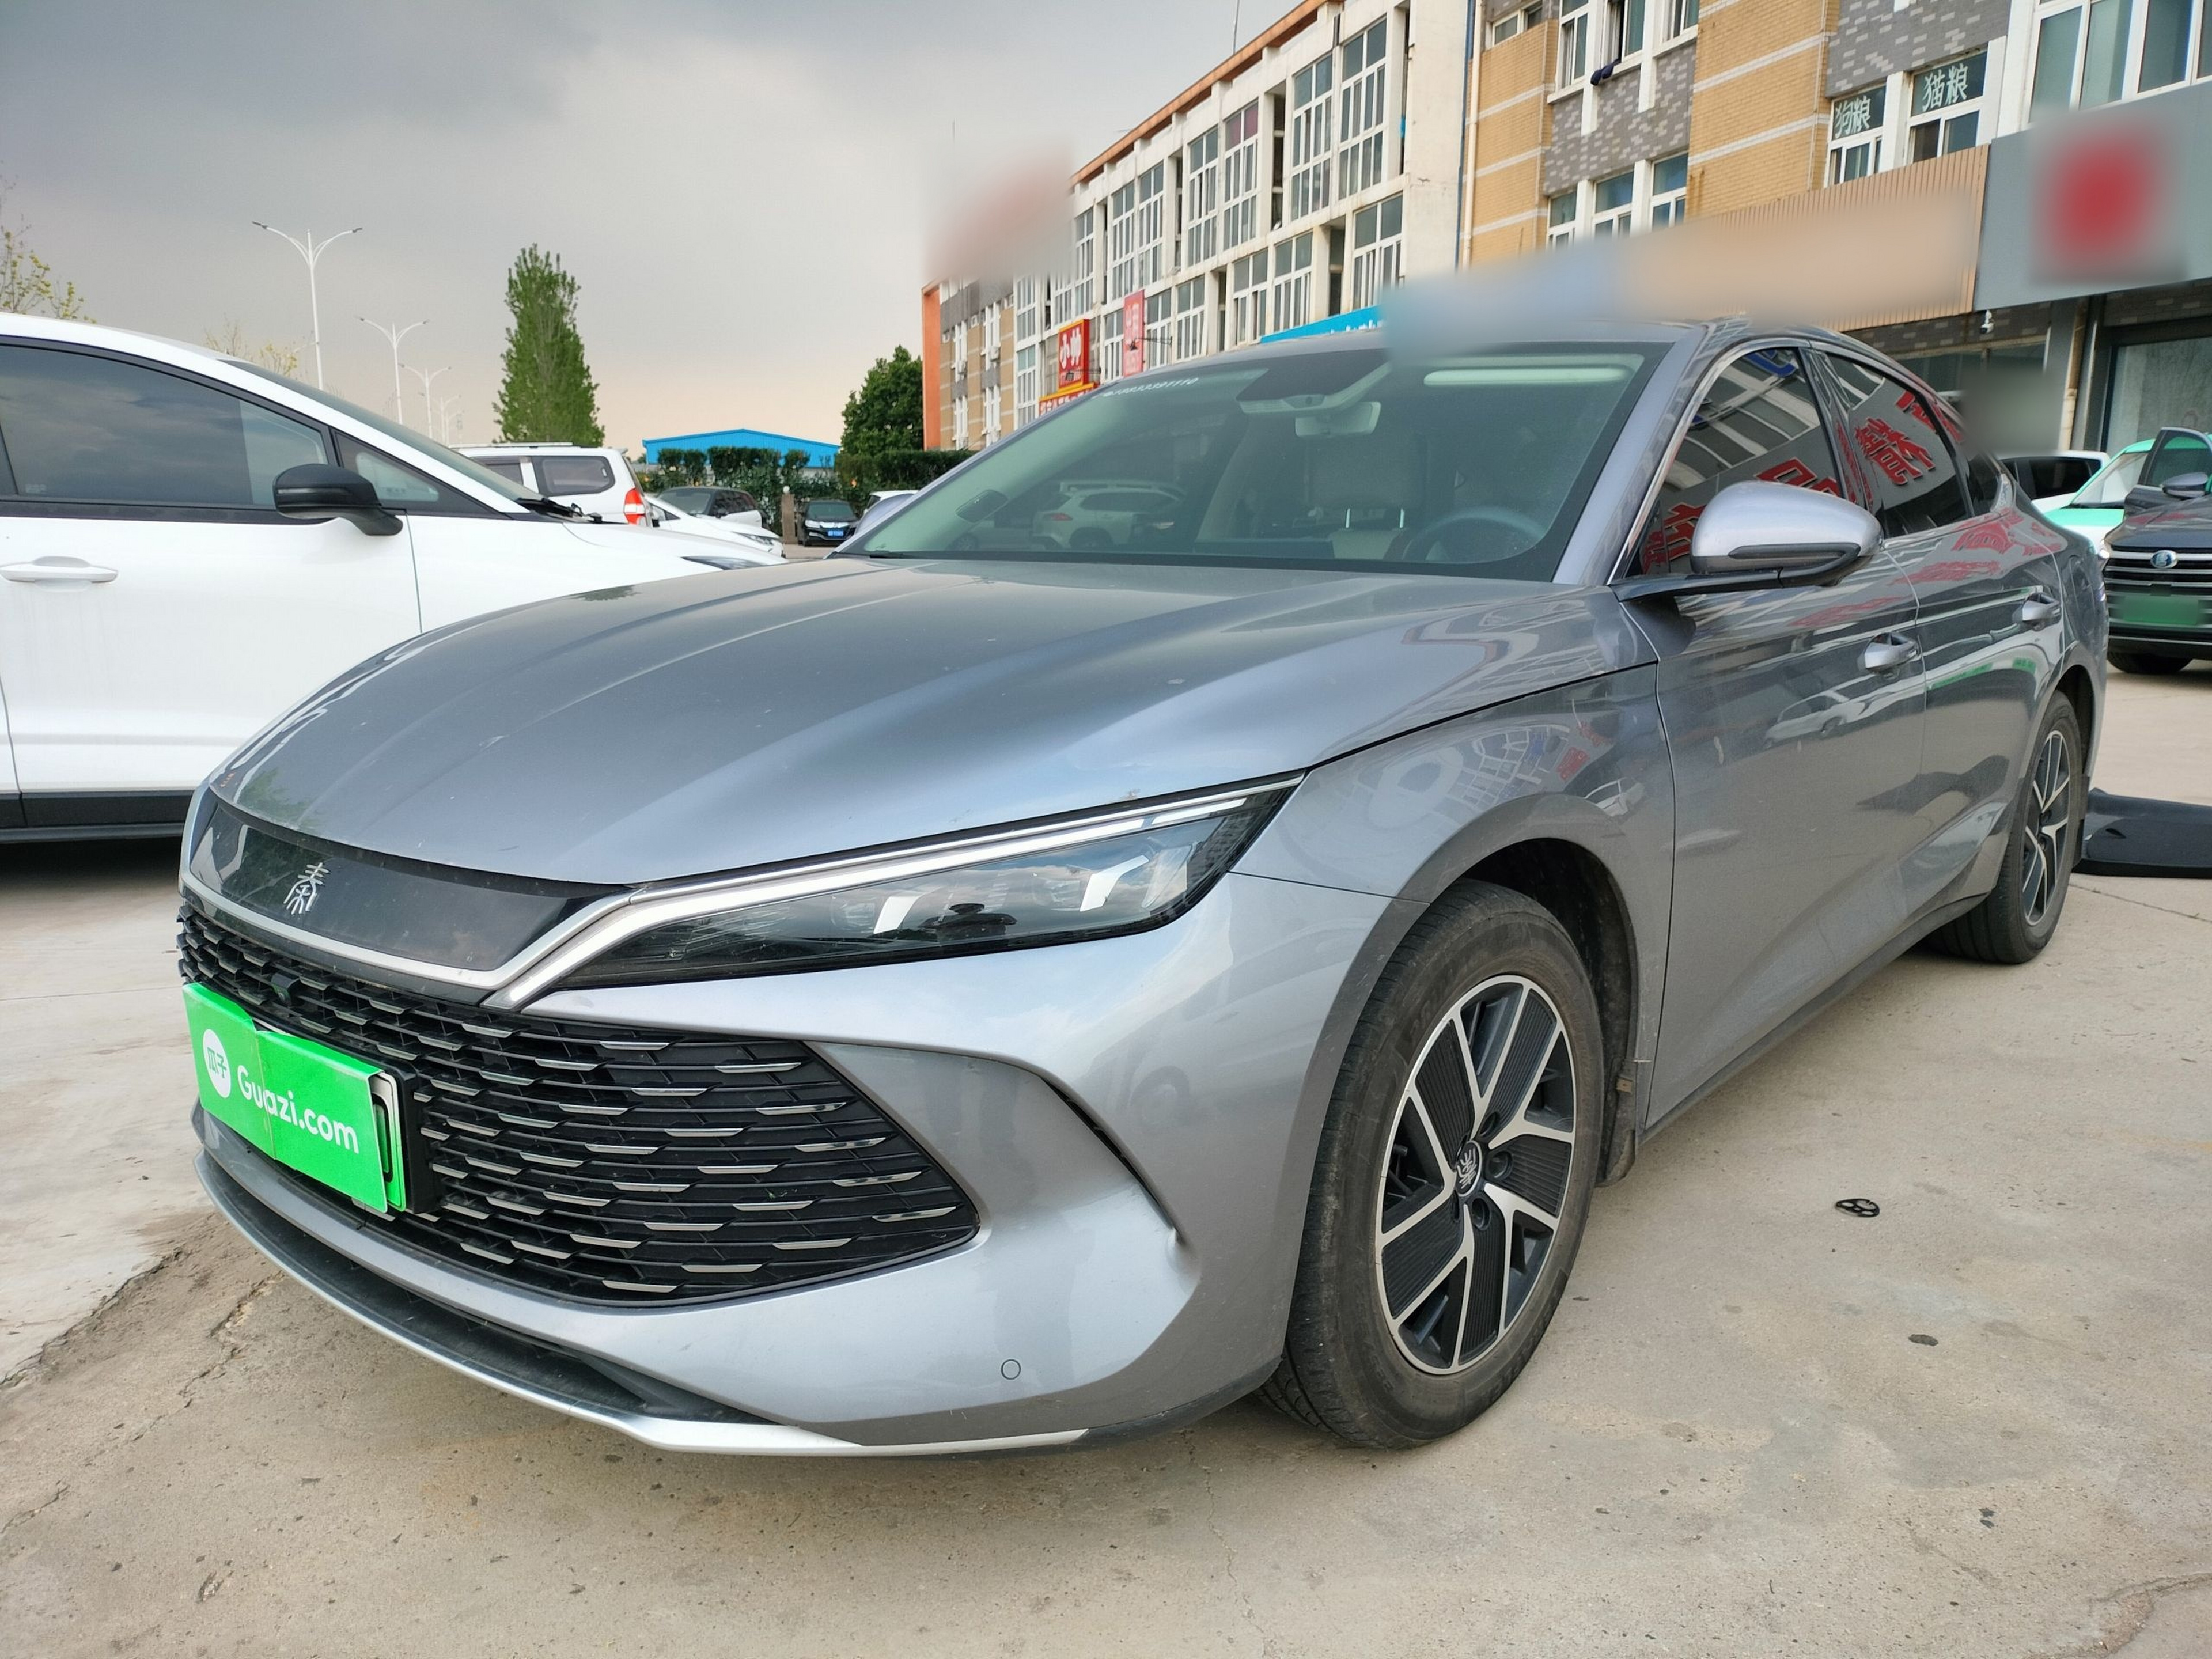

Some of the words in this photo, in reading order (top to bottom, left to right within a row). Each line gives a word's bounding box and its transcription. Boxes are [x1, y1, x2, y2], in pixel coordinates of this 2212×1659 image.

[1922, 63, 1968, 112] 猫粮
[1835, 95, 1872, 139] 狗粮
[207, 1047, 228, 1079] 瓜子
[237, 1065, 359, 1154] Guazi.com
